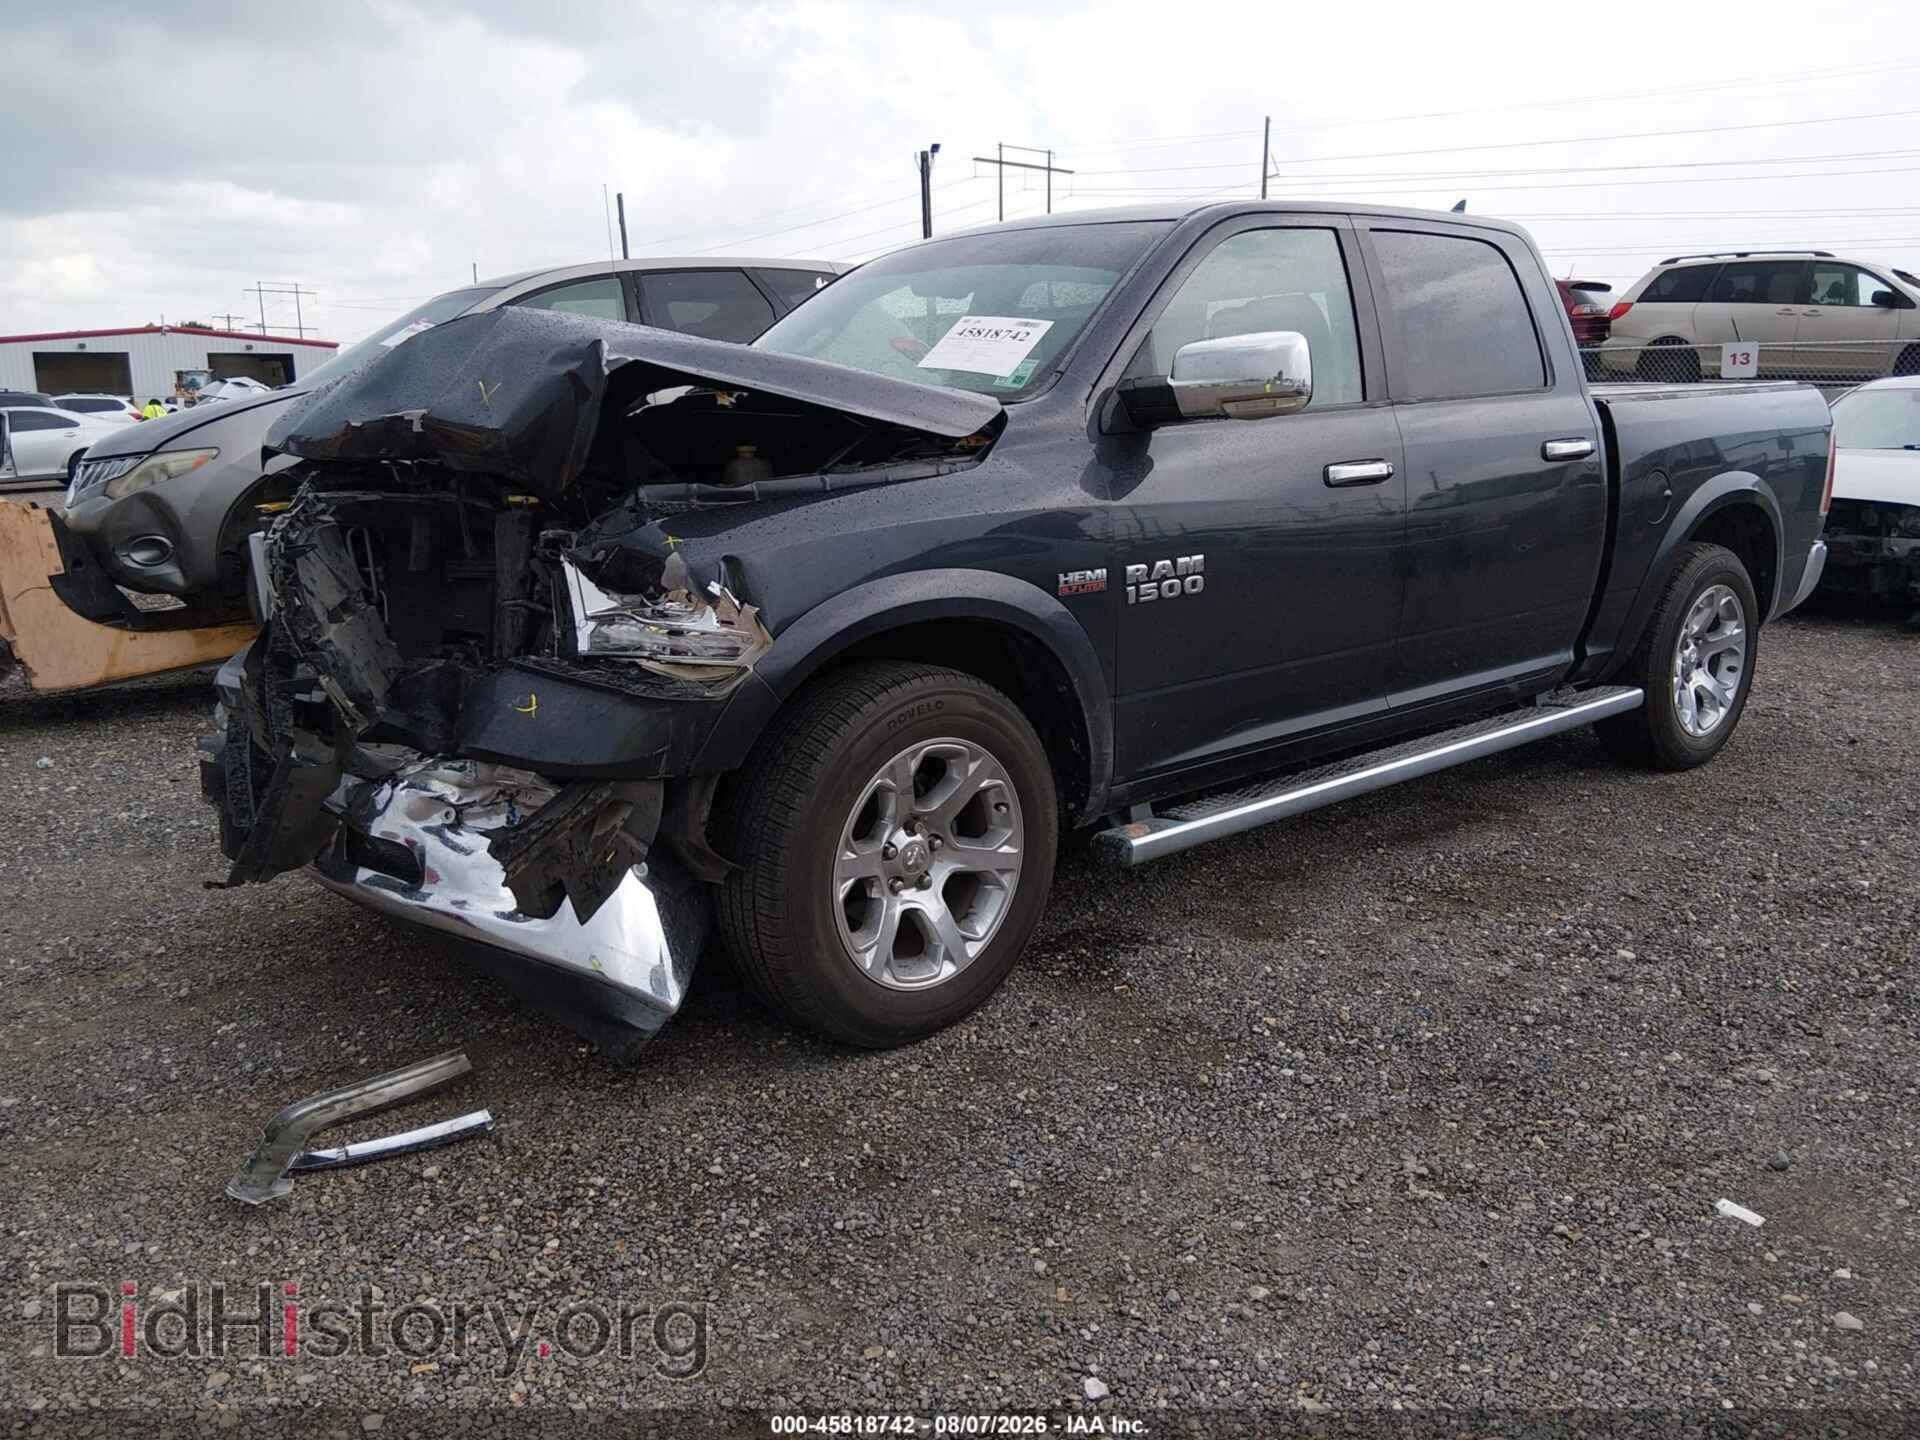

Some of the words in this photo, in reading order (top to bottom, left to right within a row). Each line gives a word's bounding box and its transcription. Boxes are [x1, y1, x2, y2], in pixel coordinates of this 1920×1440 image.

[956, 327, 1031, 342] 45818742
[1730, 352, 1750, 366] 13
[1058, 568, 1107, 586] HEMI
[1125, 554, 1205, 584] RAM
[1126, 575, 1205, 604] 1500
